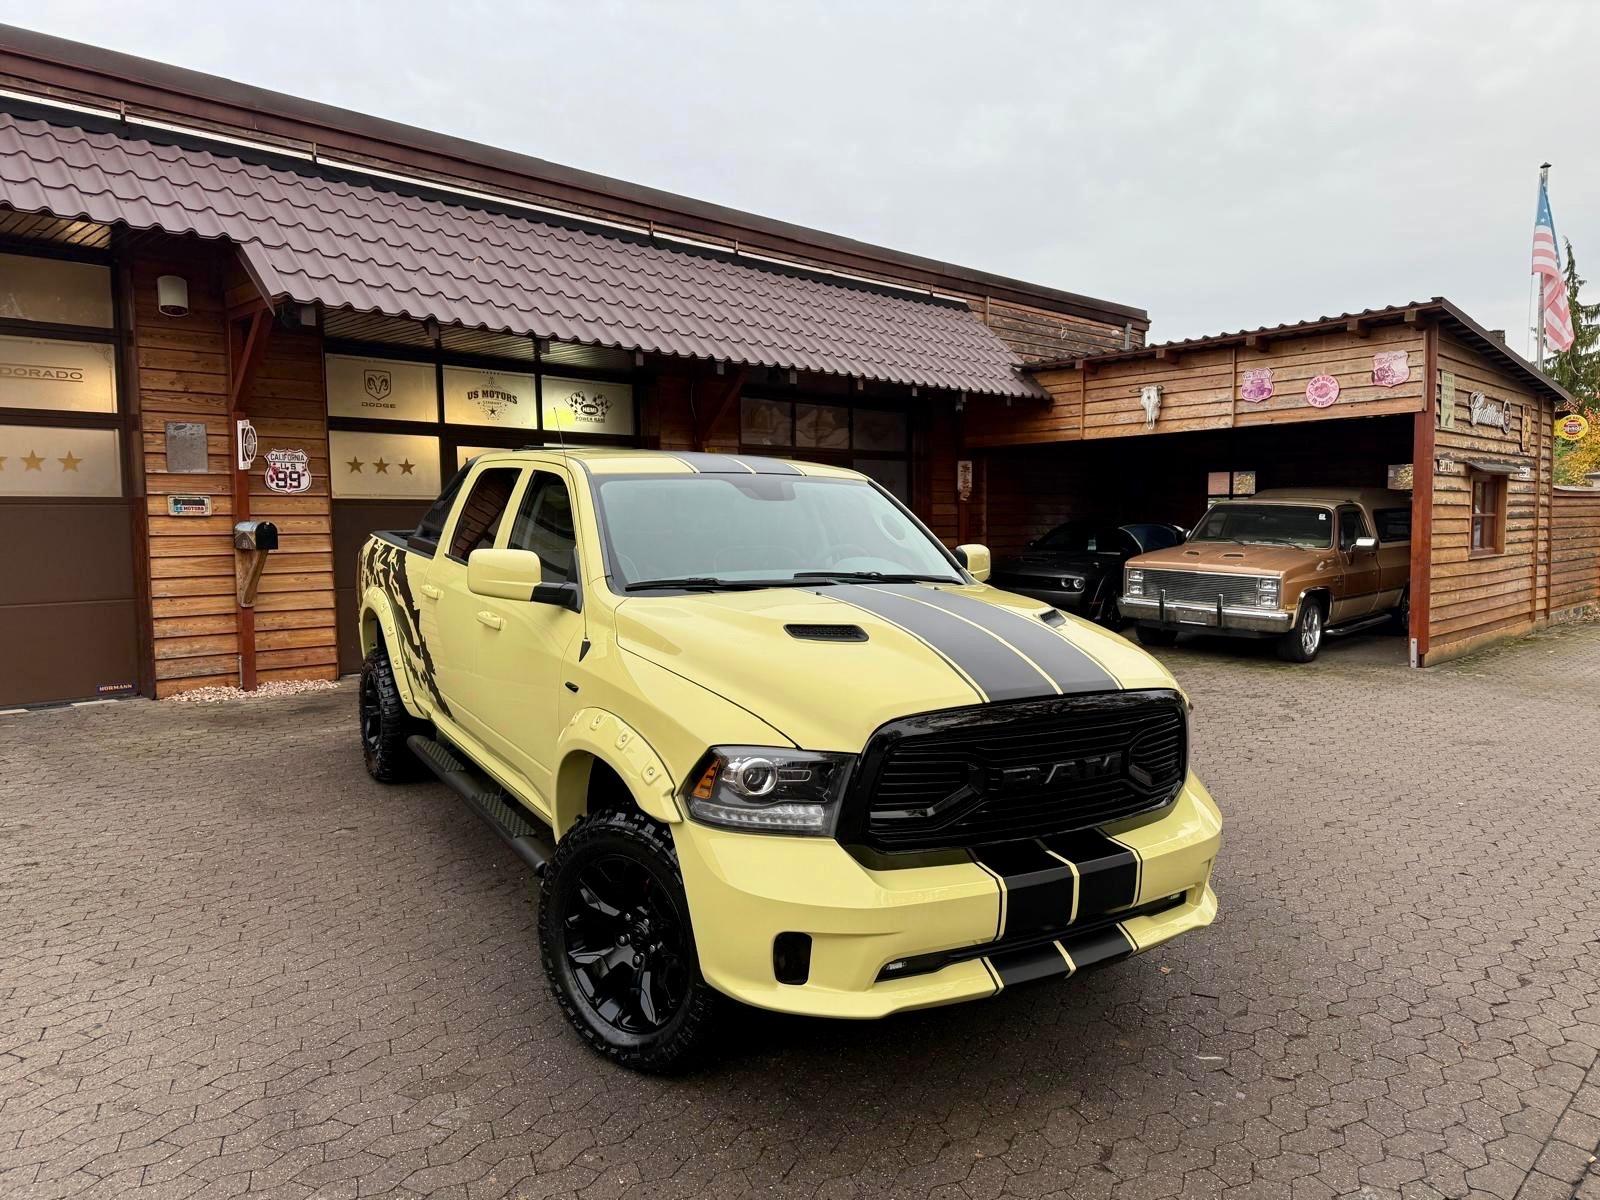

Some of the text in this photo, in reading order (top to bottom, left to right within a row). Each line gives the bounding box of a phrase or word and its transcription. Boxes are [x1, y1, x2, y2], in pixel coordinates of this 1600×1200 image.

[467, 390, 517, 404] US MOTORS
[270, 453, 305, 461] CALIFORNIA
[275, 470, 301, 489] 99
[1001, 752, 1122, 787] RAM
